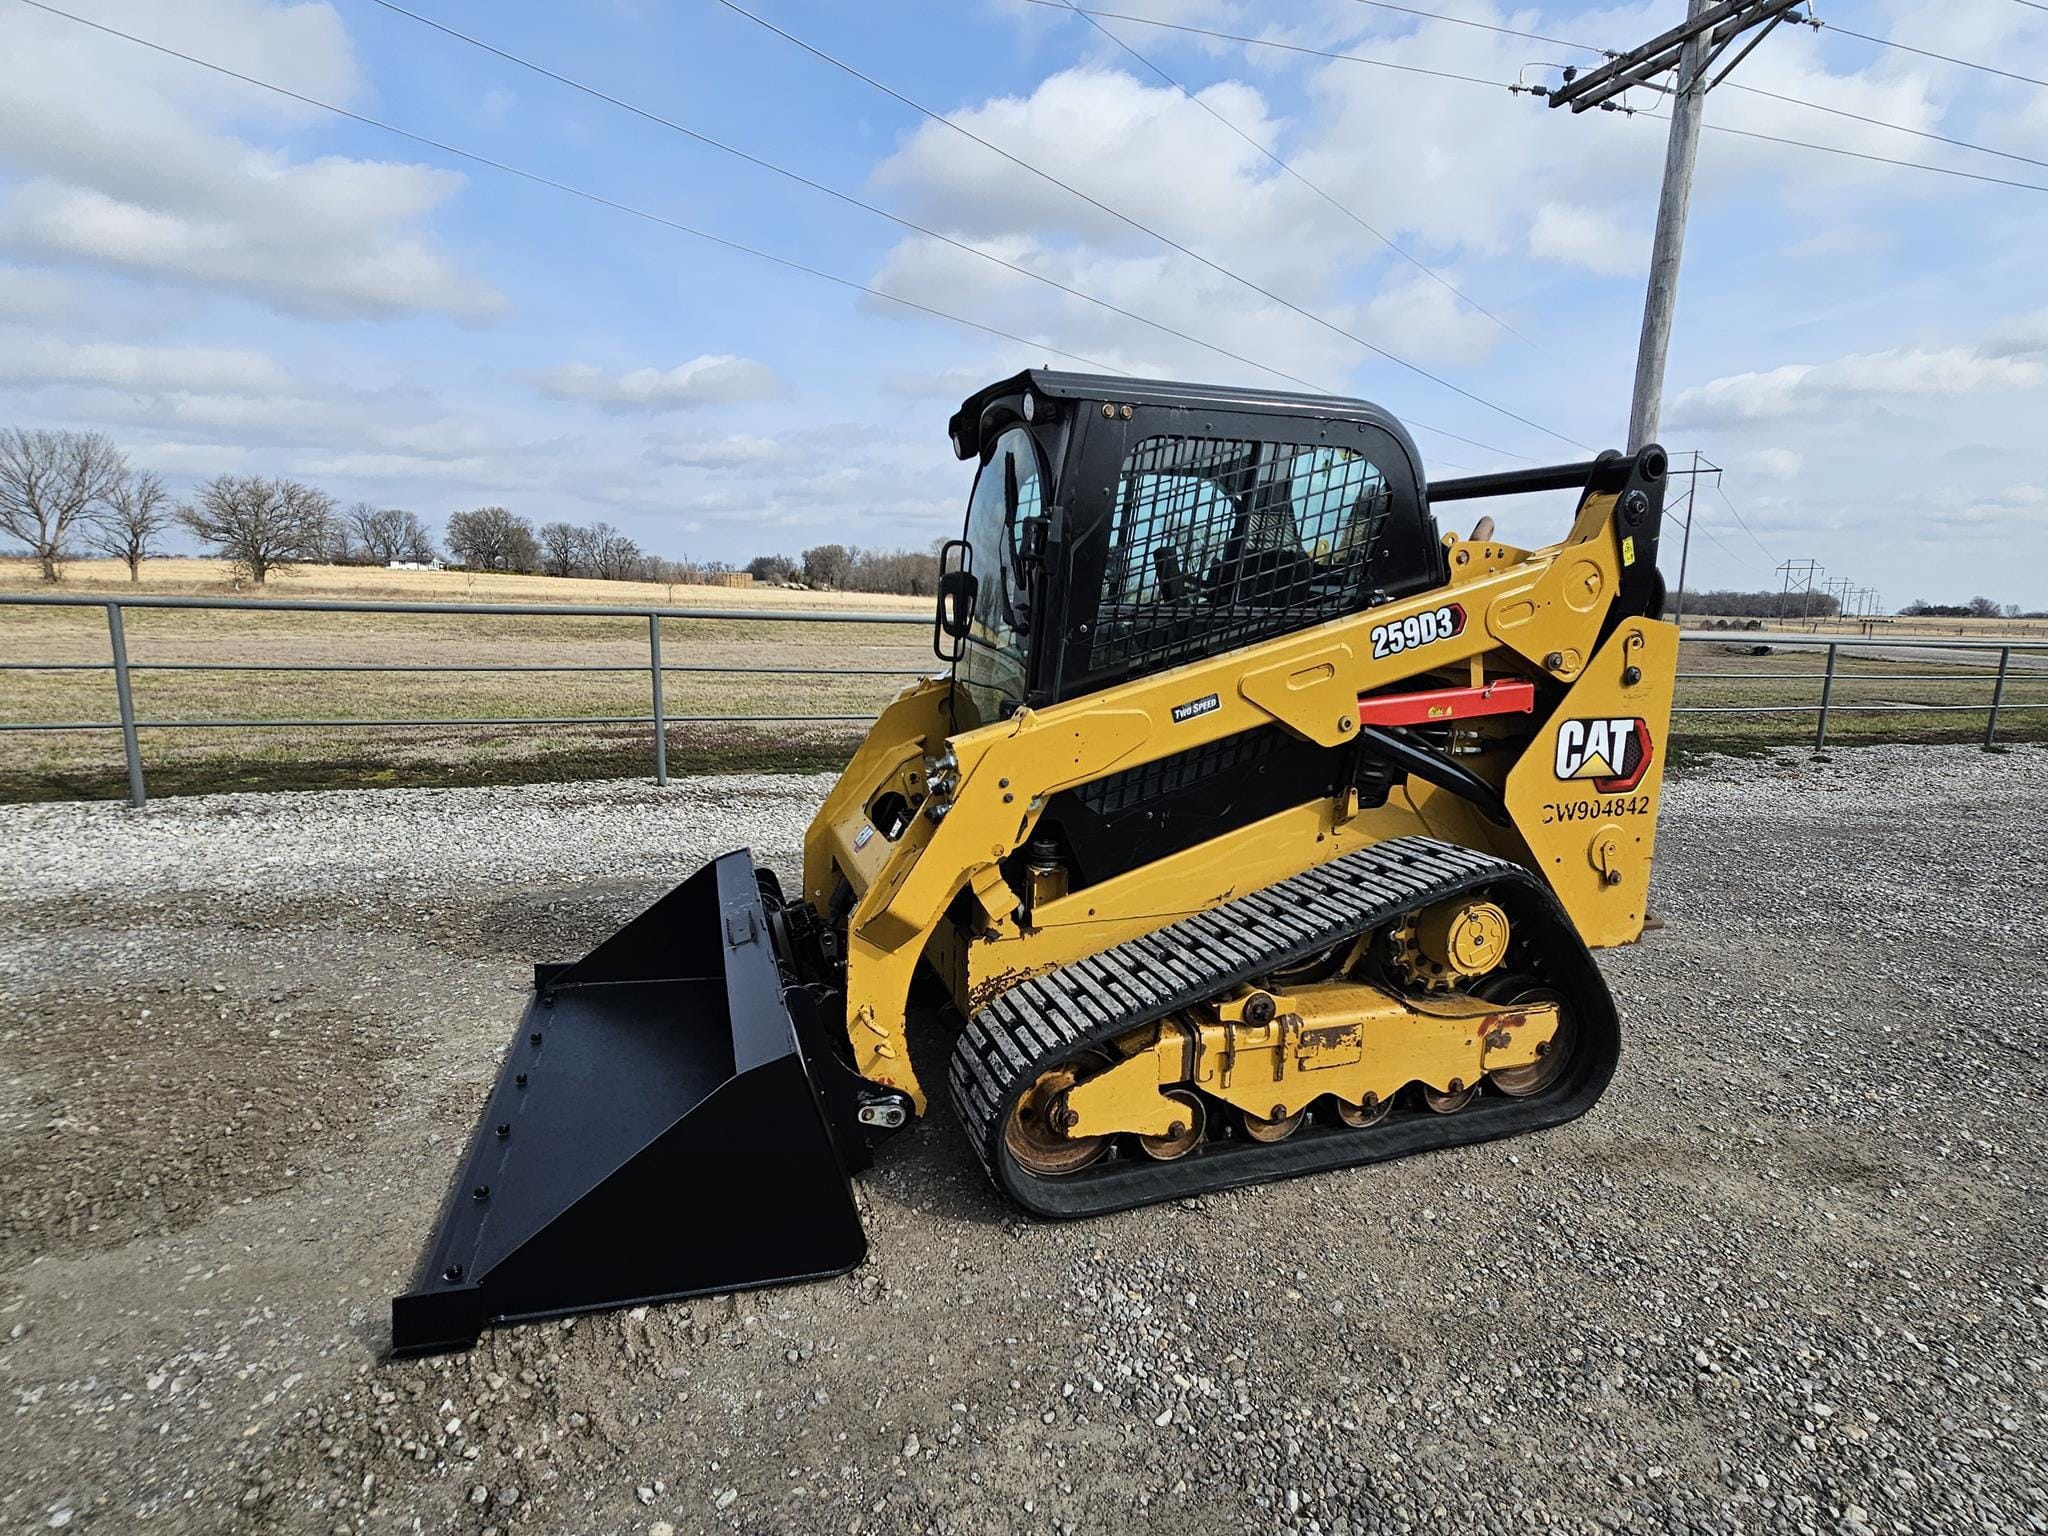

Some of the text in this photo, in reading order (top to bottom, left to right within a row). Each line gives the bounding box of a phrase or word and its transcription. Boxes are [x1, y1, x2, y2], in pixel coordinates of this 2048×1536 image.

[1371, 607, 1453, 658] 259D3
[1174, 698, 1217, 719] TWO SPEED
[1556, 719, 1634, 779] CAT
